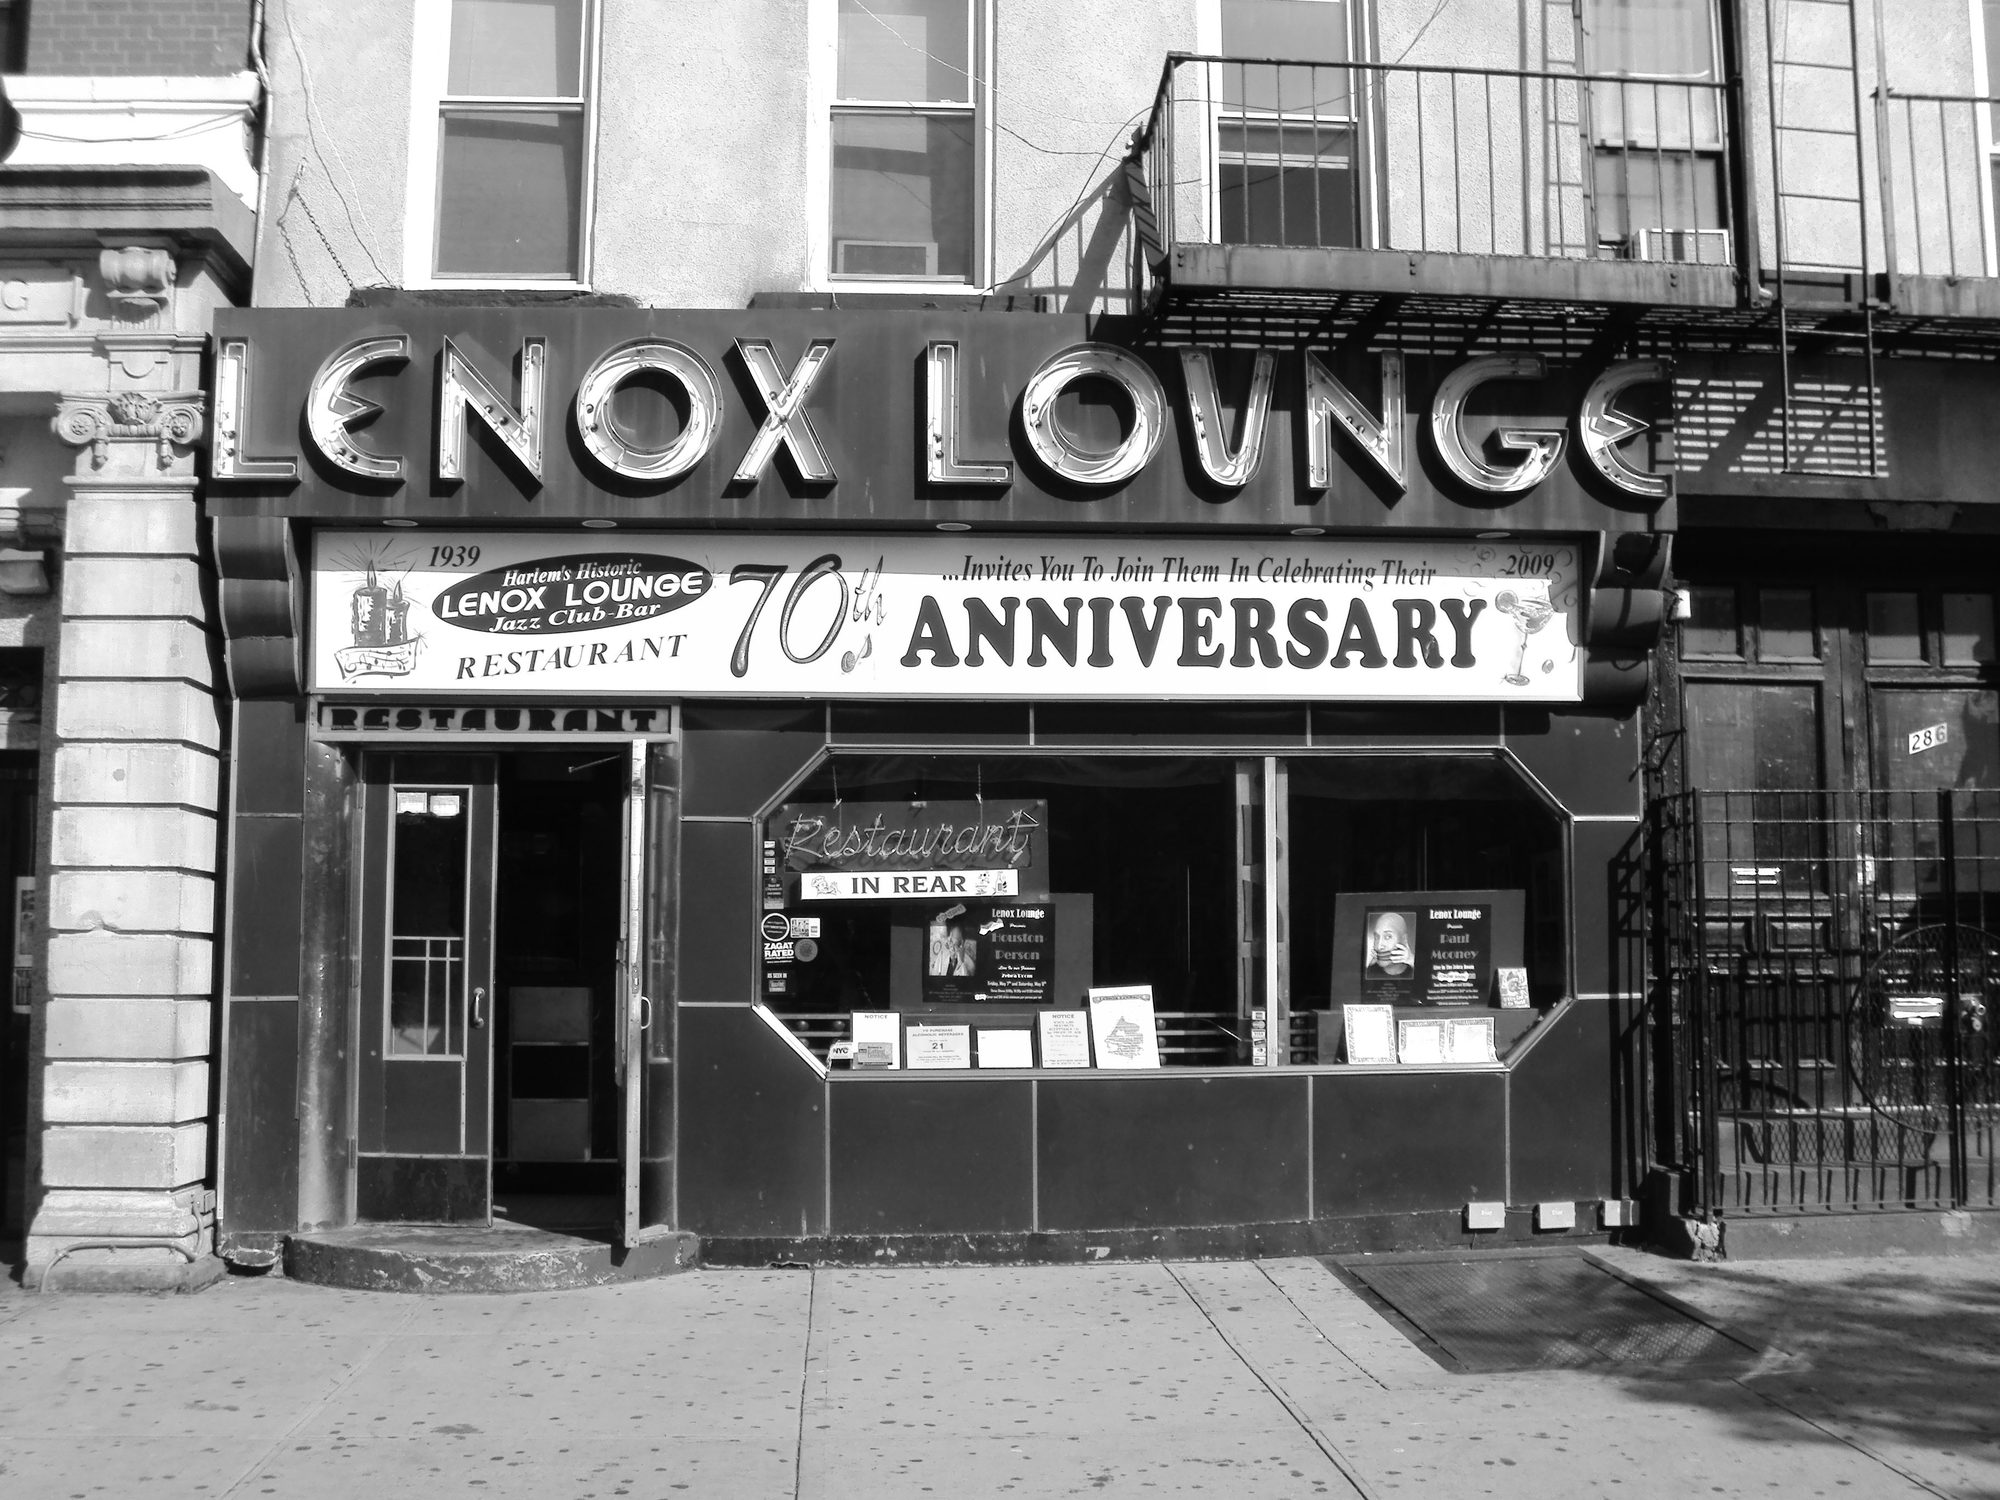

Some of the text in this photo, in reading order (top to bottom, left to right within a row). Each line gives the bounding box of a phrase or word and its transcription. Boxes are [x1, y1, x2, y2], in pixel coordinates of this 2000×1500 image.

[212, 335, 1673, 501] LENOX LOUNGE
[428, 545, 481, 568] 1939
[1505, 554, 1556, 576] 2009
[502, 558, 643, 587] Harlem's Historic
[942, 555, 1437, 592] ...Invites You To Join Them In Celebrating Their
[441, 571, 704, 619] LENOX LOUNGE
[489, 602, 662, 633] Jazz Club-Bar
[900, 595, 1488, 668] ANNIVERSARY
[456, 634, 688, 680] RESTAURANT
[331, 708, 657, 731] RESTAURANT
[1911, 725, 1947, 751] 286
[784, 811, 1040, 858] Restaurant
[852, 875, 967, 894] IN REAR
[991, 908, 1045, 919] Lenox Lounge
[1430, 909, 1481, 920] Lenox Lounge
[764, 942, 794, 950] ZAGAT
[991, 932, 1044, 943] Houston
[1440, 933, 1469, 944] Paul
[995, 950, 1040, 960] Person
[1431, 950, 1480, 960] Mooney
[932, 1042, 944, 1050] 21
